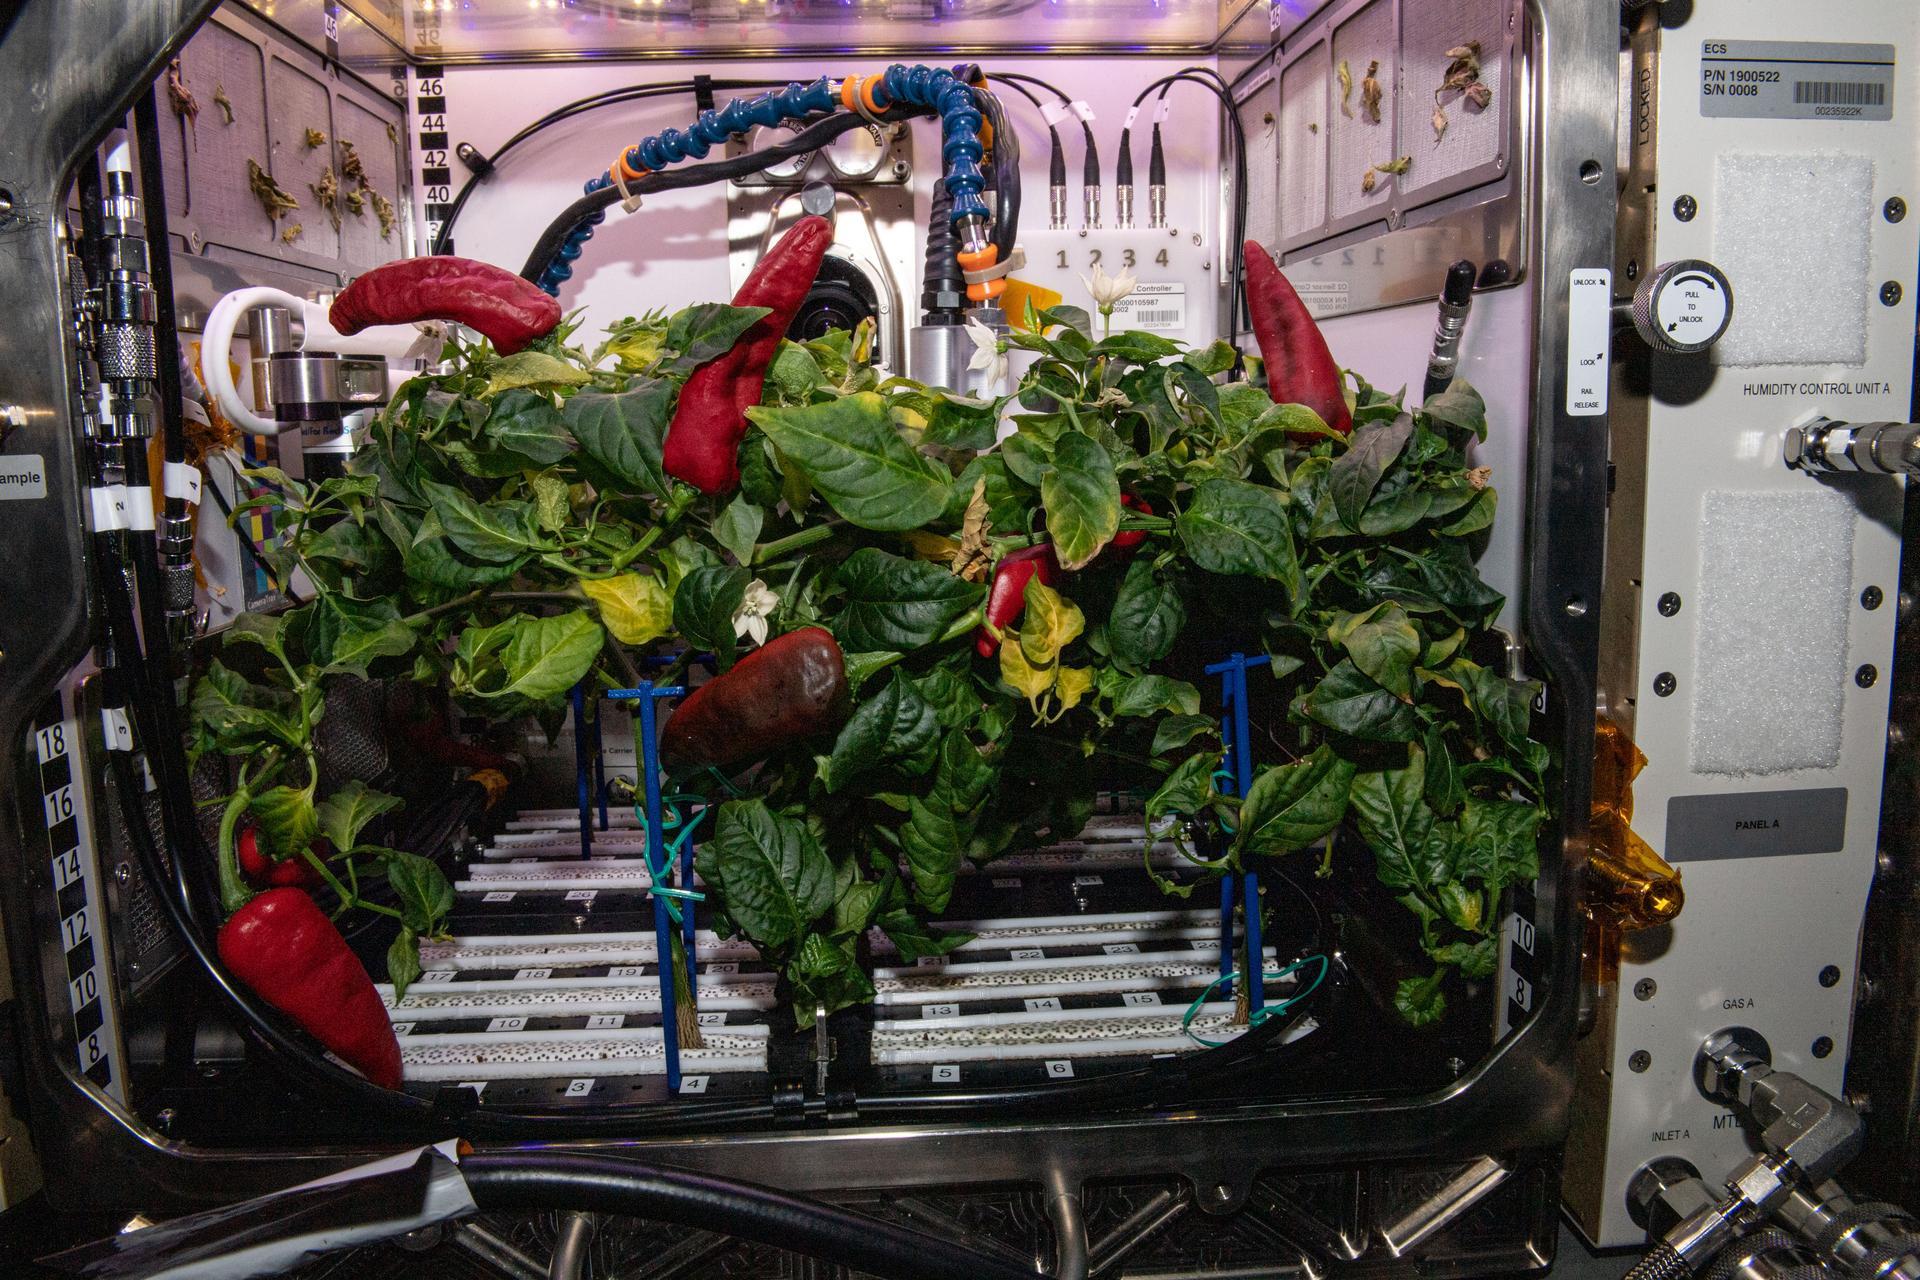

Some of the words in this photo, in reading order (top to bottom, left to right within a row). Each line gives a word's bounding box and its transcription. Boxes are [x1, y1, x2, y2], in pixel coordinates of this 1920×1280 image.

[1704, 44, 1727, 54] ECS
[1704, 70, 1725, 82] P/N
[1729, 71, 1780, 83] 1900522
[420, 79, 443, 96] 46
[1703, 84, 1725, 95] S/N
[1729, 85, 1758, 96] 0008
[1640, 68, 1651, 146] LOCKED
[1815, 106, 1862, 116] 00235922K
[422, 115, 445, 131] 44
[425, 151, 447, 167] 42
[427, 186, 450, 203] 40
[1057, 250, 1069, 269] 1
[1089, 249, 1102, 268] 2
[1122, 249, 1136, 268] 3
[1155, 249, 1169, 267] 4
[1743, 384, 1797, 395] HUMIDITY
[1800, 383, 1852, 395] CONTROL
[1855, 383, 1880, 395] UNIT
[1882, 383, 1891, 394] A
[0, 471, 41, 487] ample
[189, 480, 199, 491] 4
[115, 501, 124, 511] 2
[118, 726, 127, 735] 3
[41, 724, 65, 759] 18
[50, 787, 73, 822] 16
[1735, 820, 1770, 830] PANEL
[1772, 819, 1780, 829] A
[58, 850, 81, 885] 14
[66, 911, 89, 946] 12
[1516, 917, 1533, 952] 10
[1019, 951, 1041, 959] 22
[1110, 946, 1133, 954] 23
[1195, 941, 1219, 949] 24
[429, 973, 451, 981] 17
[525, 970, 546, 978] 18
[615, 968, 637, 976] 19
[711, 965, 735, 973] 20
[76, 971, 97, 1007] 10
[1516, 977, 1525, 1006] 8
[929, 1006, 952, 1016] 13
[1031, 1000, 1053, 1009] 14
[1131, 995, 1153, 1003] 15
[1722, 999, 1745, 1010] GAS
[1746, 998, 1755, 1008] A
[499, 1019, 521, 1029] 10
[596, 1017, 616, 1025] 11
[698, 1014, 720, 1023] 12
[88, 1034, 100, 1064] 8
[938, 1068, 952, 1078] 5
[1052, 1063, 1066, 1073] 6
[571, 1082, 586, 1092] 3
[687, 1079, 700, 1089] 4
[1651, 1131, 1682, 1142] INLET
[1682, 1129, 1691, 1139] A
